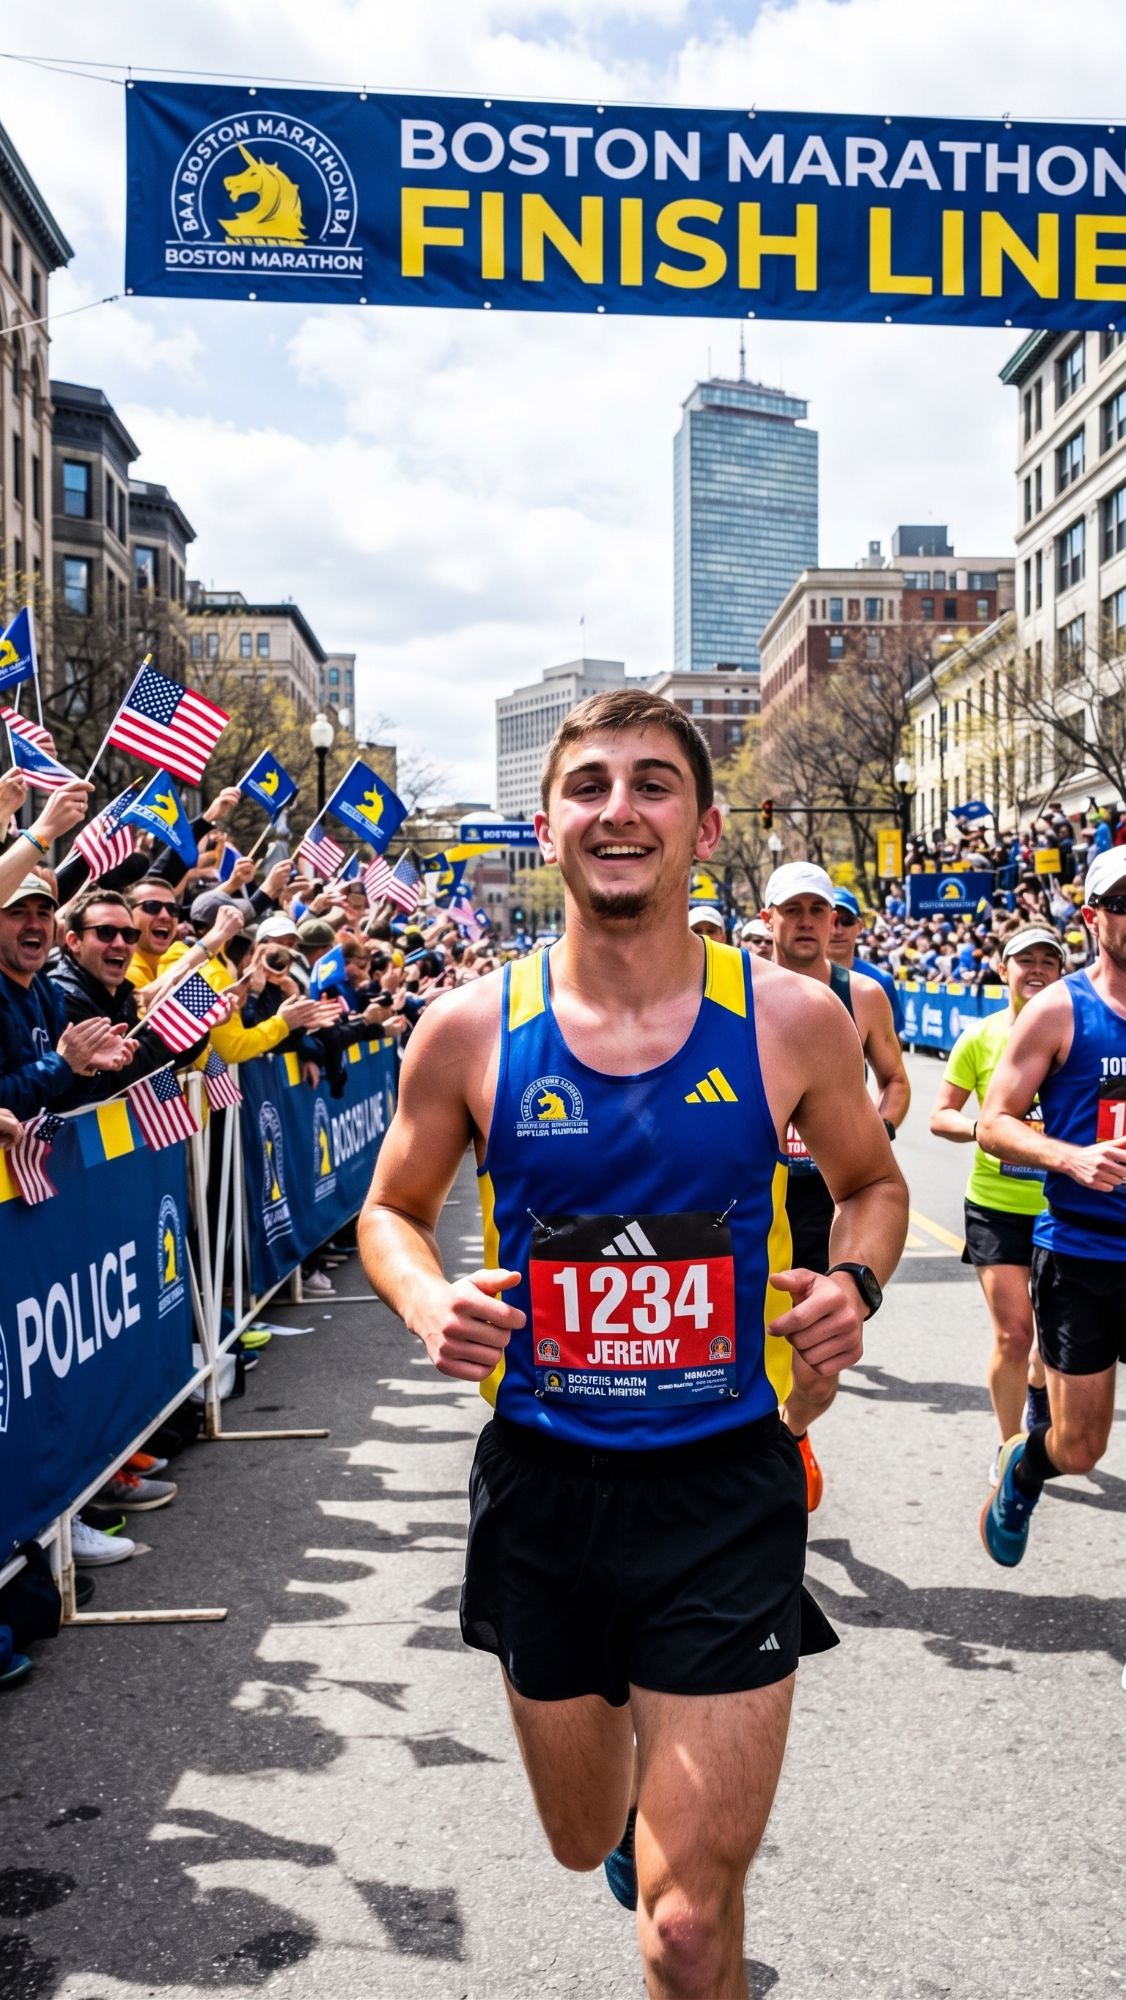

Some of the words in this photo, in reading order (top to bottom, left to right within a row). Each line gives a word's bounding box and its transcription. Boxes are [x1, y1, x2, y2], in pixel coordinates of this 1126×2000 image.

[181, 120, 250, 186] BOSTON
[257, 118, 349, 203] MARATHON
[400, 118, 700, 182] BOSTON
[728, 131, 1126, 198] MARATHON
[178, 191, 200, 232] BAA
[329, 208, 351, 235] BA
[165, 248, 246, 267] BOSTON
[251, 251, 363, 271] MARATHON
[400, 187, 818, 292] FINISH
[869, 207, 1126, 302] LINE
[483, 830, 520, 839] BOSTON
[16, 1240, 141, 1400] POLICE
[553, 1264, 714, 1335] 1234
[587, 1338, 681, 1365] JEREMY
[568, 1385, 606, 1396] OFFICIAL
